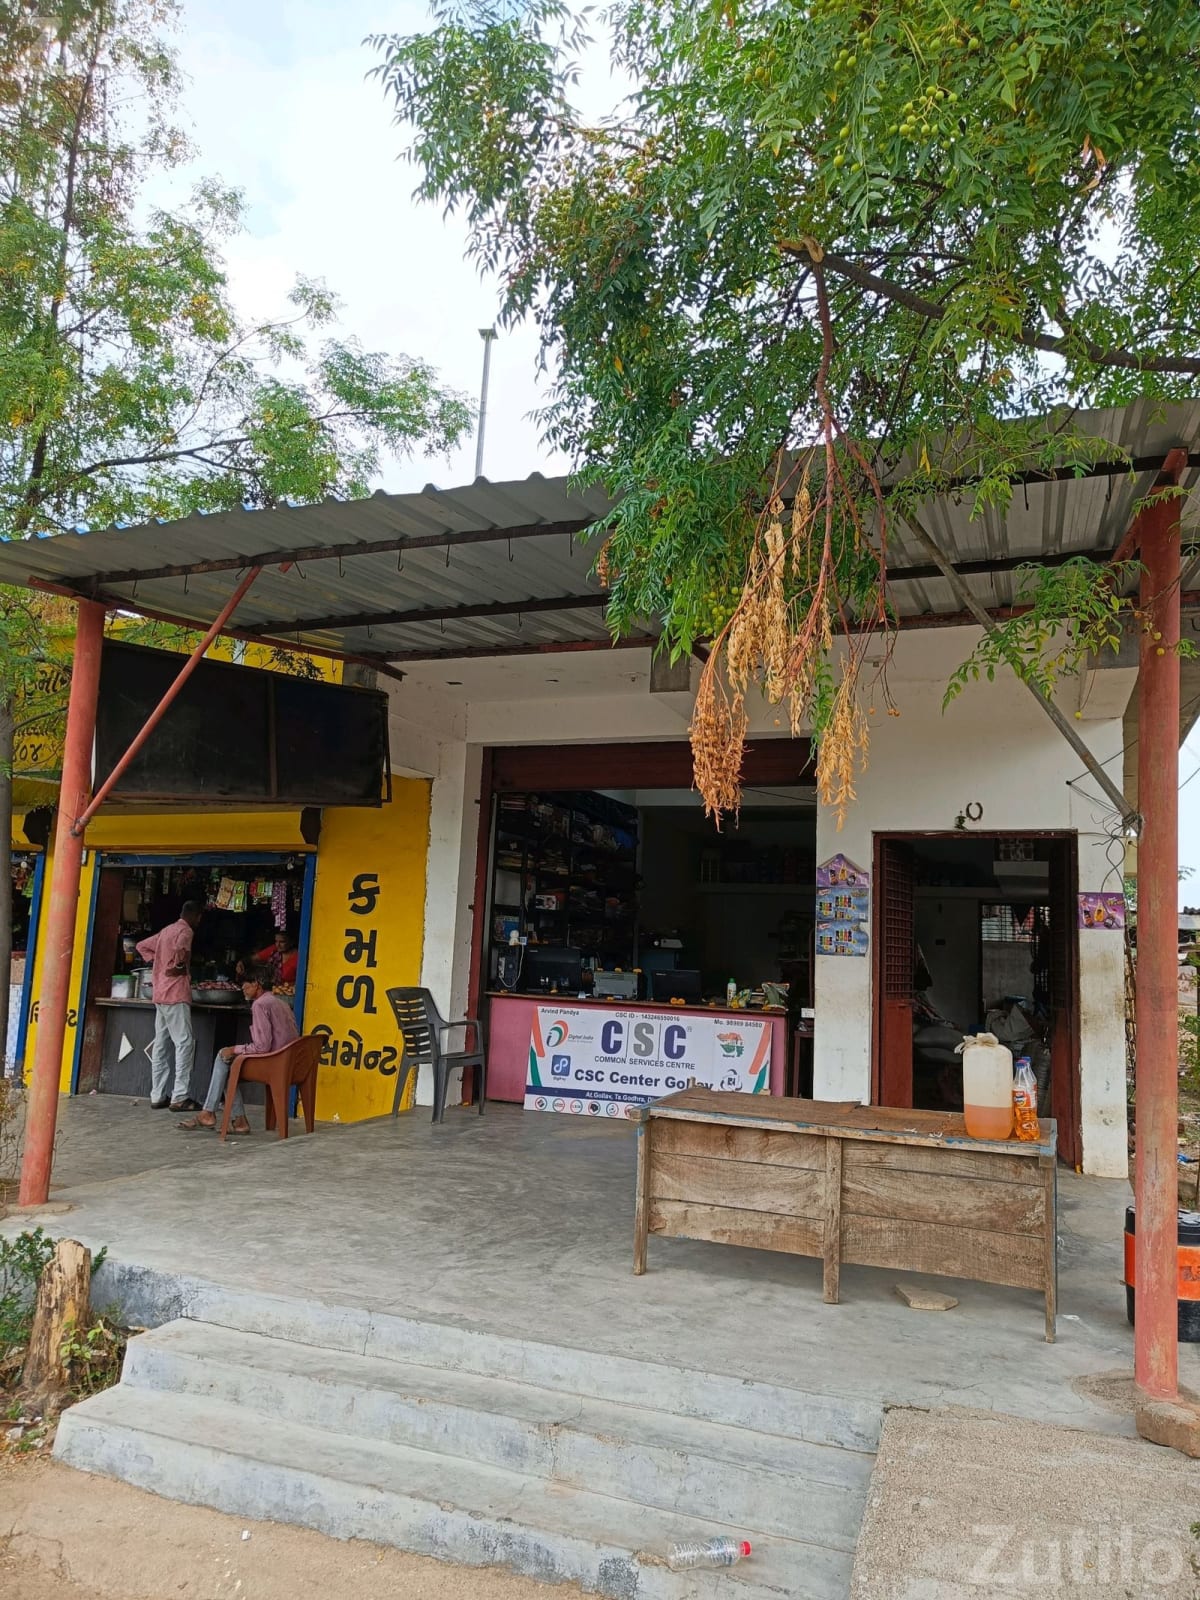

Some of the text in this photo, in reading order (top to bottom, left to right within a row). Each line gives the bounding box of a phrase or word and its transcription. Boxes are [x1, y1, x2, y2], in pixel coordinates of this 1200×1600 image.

[541, 1007, 579, 1017] Arvind Pandya
[594, 1056, 696, 1070] COMMON SERVICES CENTRE
[574, 1069, 605, 1082] CSC
[610, 1071, 661, 1087] Center
